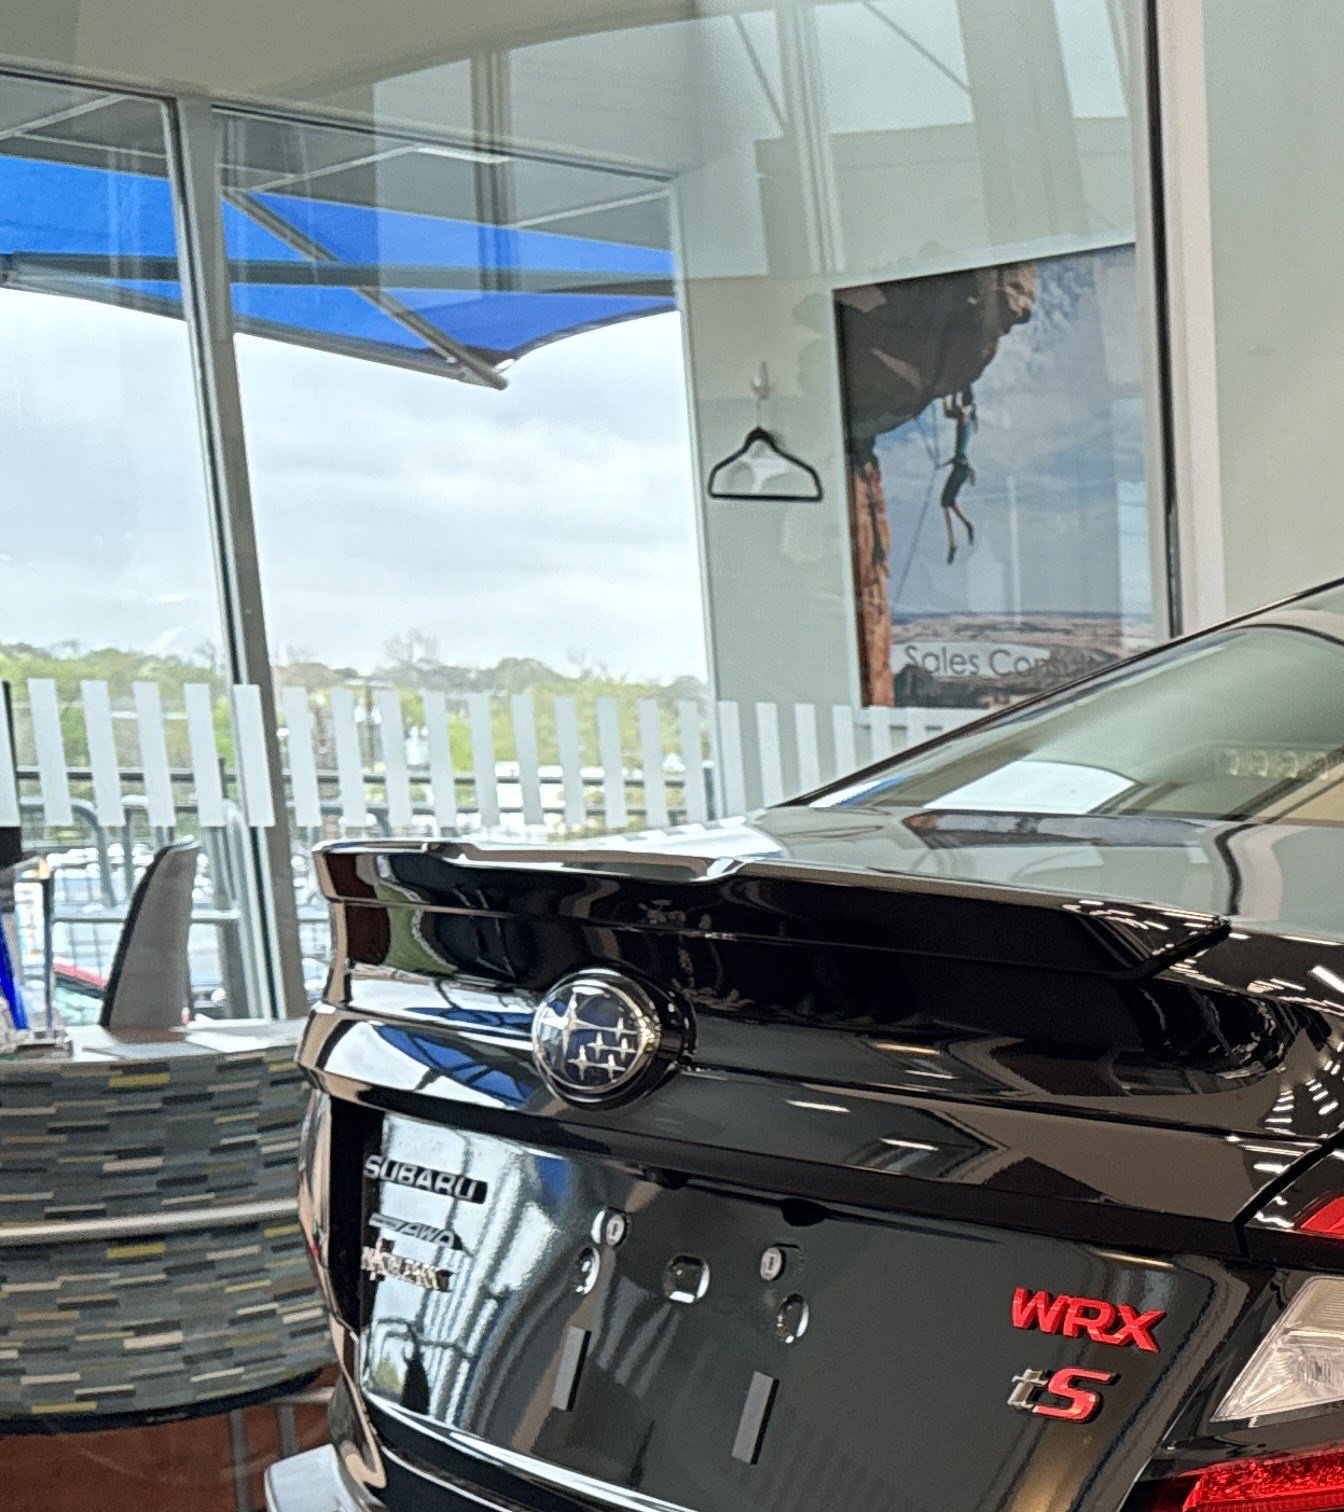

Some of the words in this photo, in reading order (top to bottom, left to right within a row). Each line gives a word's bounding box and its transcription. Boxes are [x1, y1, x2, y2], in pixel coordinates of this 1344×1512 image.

[904, 645, 979, 675] Sales
[364, 1154, 478, 1201] SUBARU
[1010, 1286, 1168, 1354] WRX
[1006, 1367, 1118, 1422] tS
